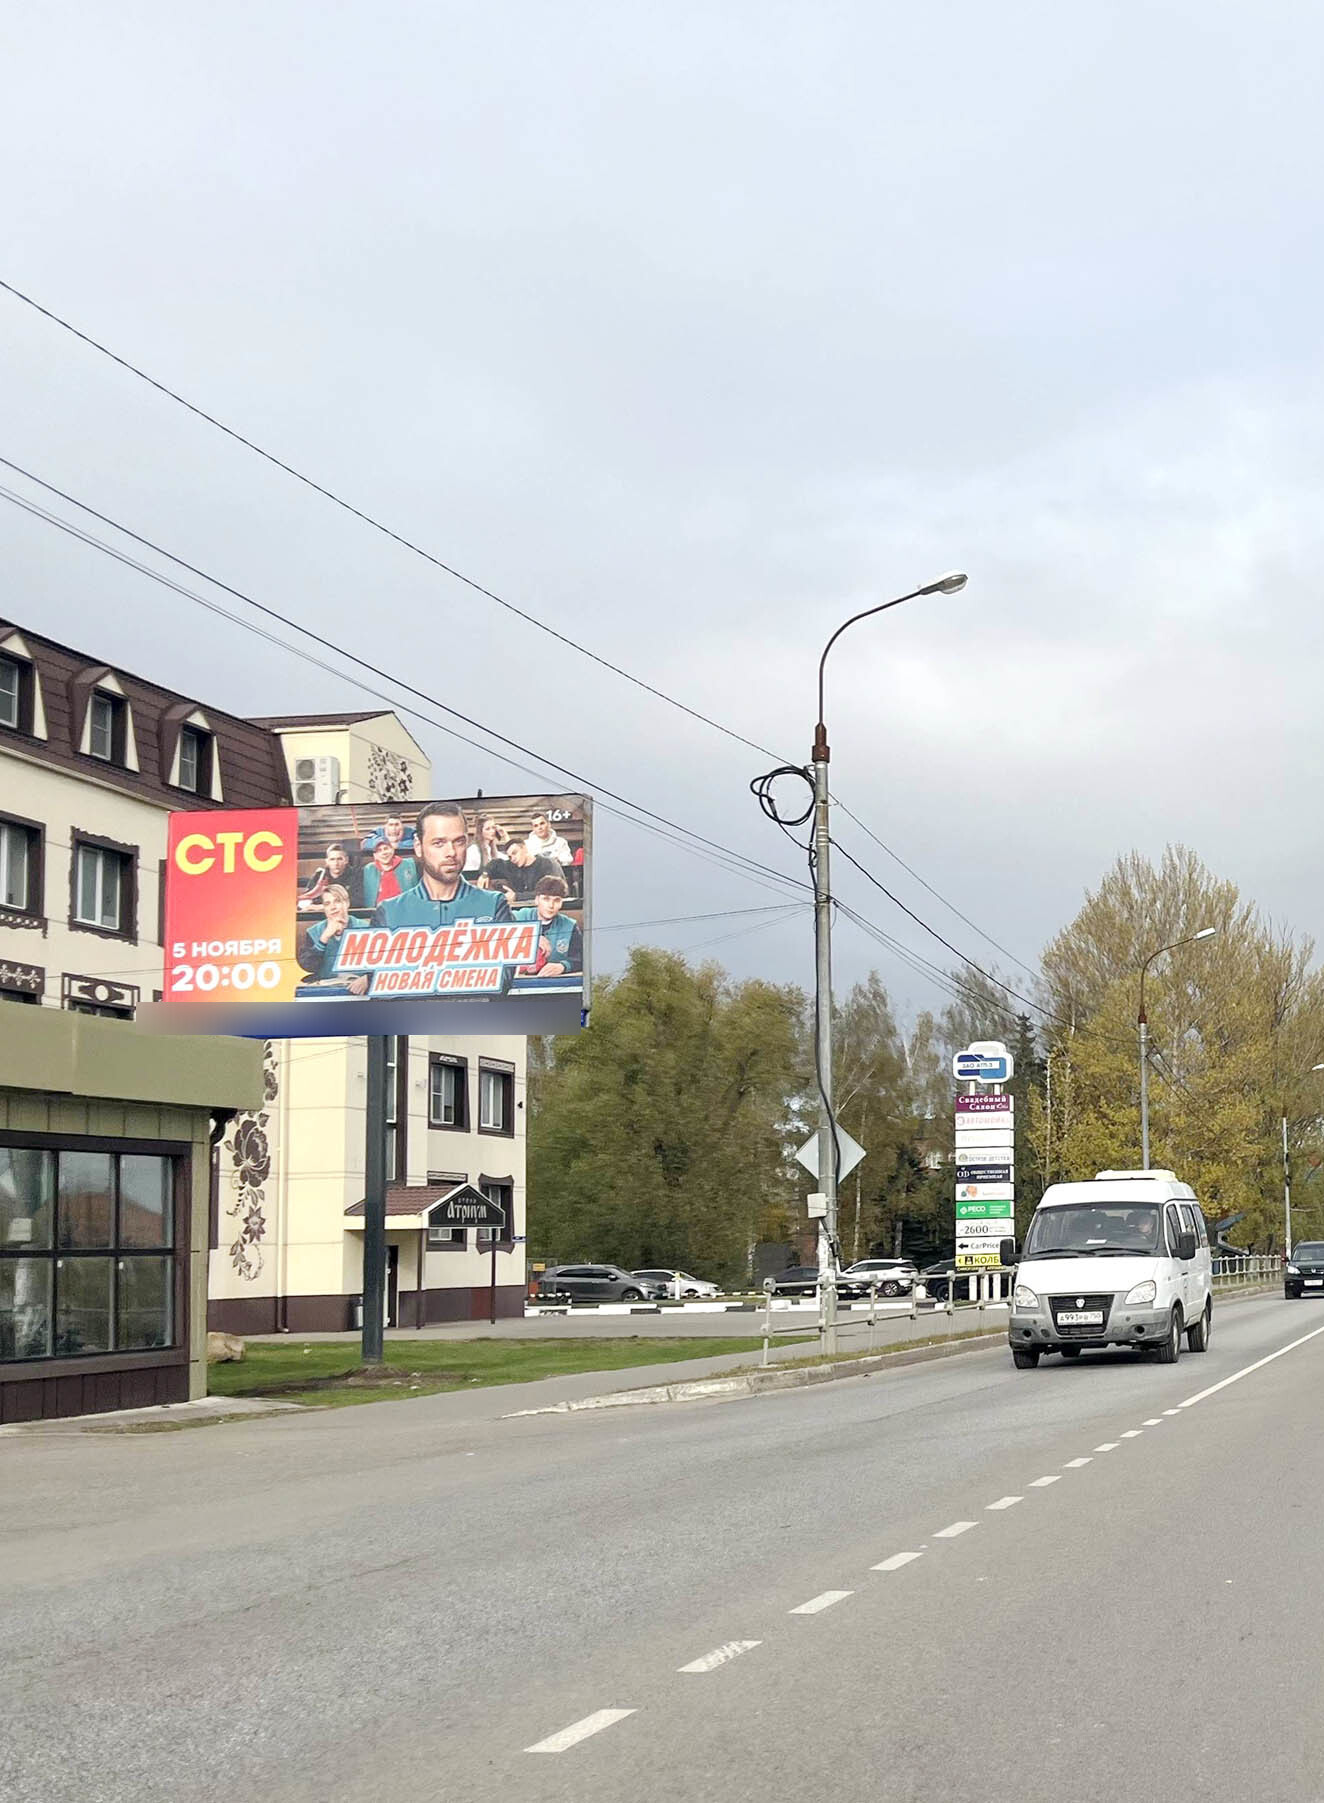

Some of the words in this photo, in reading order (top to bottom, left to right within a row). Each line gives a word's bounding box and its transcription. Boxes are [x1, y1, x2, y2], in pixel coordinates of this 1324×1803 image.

[546, 809, 571, 821] 16+
[175, 831, 284, 875] СТС
[172, 942, 186, 958] 5
[191, 938, 281, 958] НОЯБРЯ
[340, 922, 537, 967] МОЛОДЁЖКА
[171, 961, 281, 992] 20:00
[374, 970, 434, 992] НОВАЯ
[438, 968, 500, 989] СМЕНА
[958, 1096, 1007, 1104] Свадебный
[447, 1200, 487, 1224] Атриум
[970, 1242, 1000, 1250] CarPrice
[974, 1256, 999, 1265] КОЛБ
